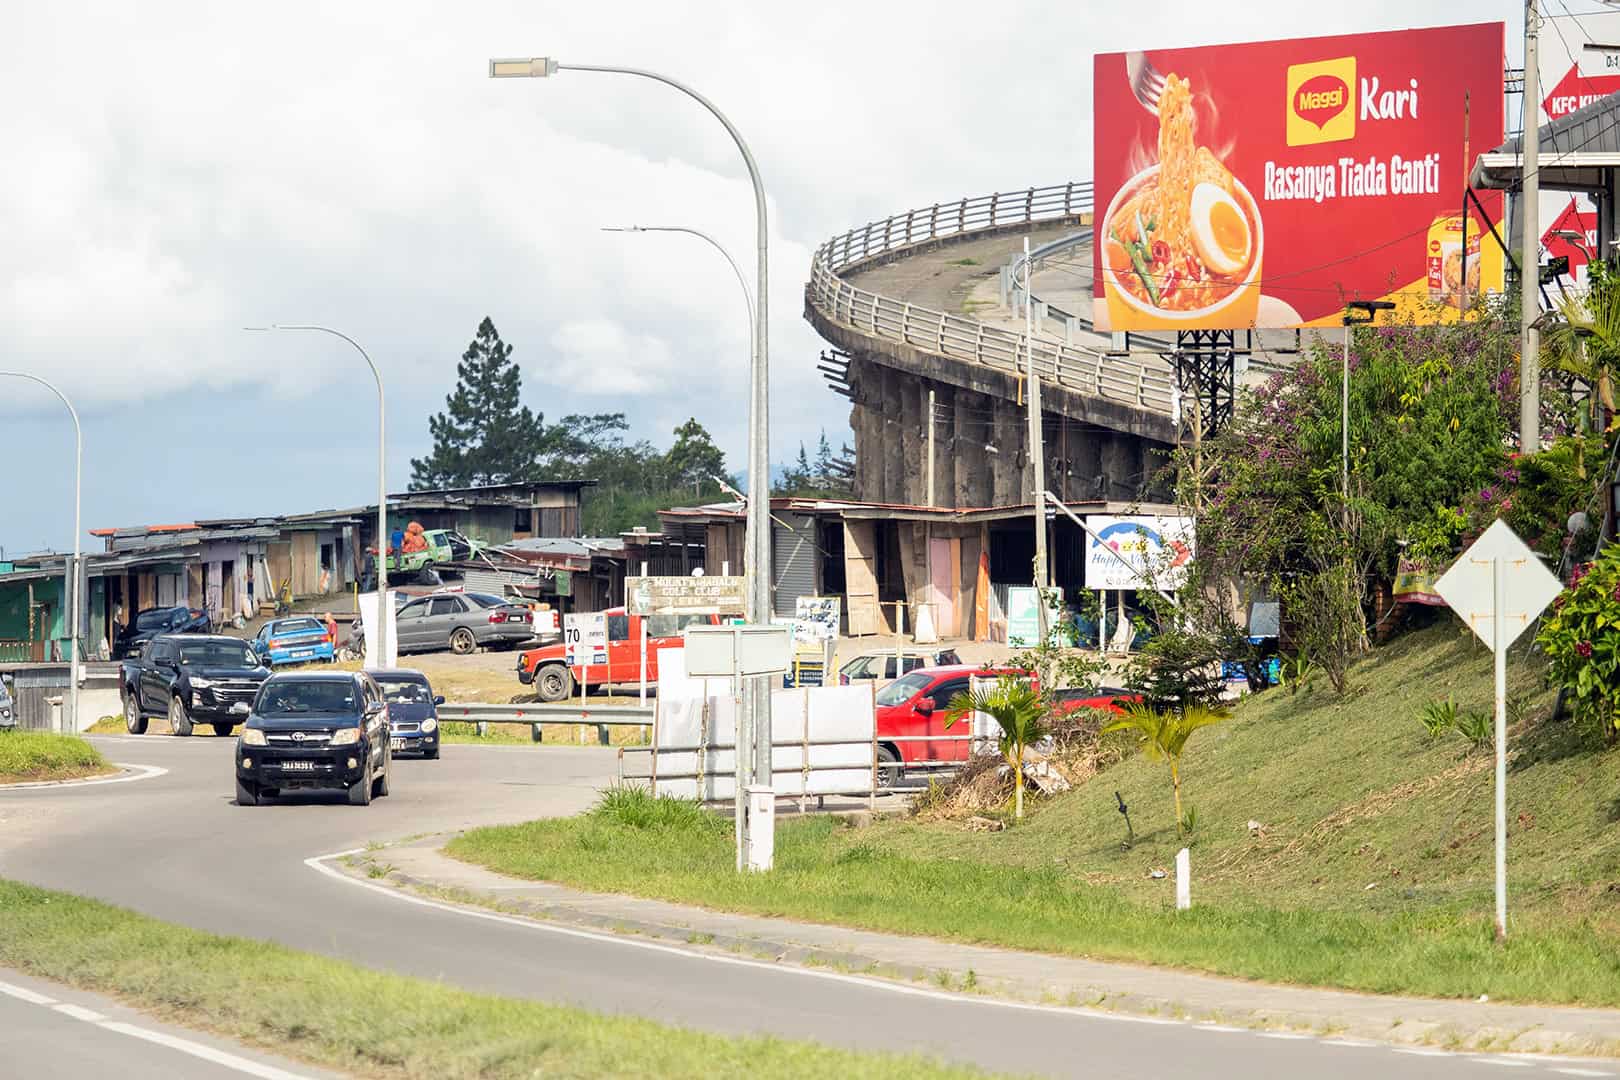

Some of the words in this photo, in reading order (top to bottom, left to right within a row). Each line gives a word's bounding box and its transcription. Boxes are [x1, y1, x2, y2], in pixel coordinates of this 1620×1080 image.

[1300, 86, 1343, 111] Maggi
[1360, 76, 1418, 121] Kari
[1552, 95, 1577, 114] KFC
[1264, 161, 1336, 203] Rasanya
[1338, 156, 1387, 197] Tiada
[1391, 153, 1440, 195] Ganti
[662, 587, 688, 596] GOLF
[694, 586, 721, 596] CLUB
[566, 628, 580, 643] 70
